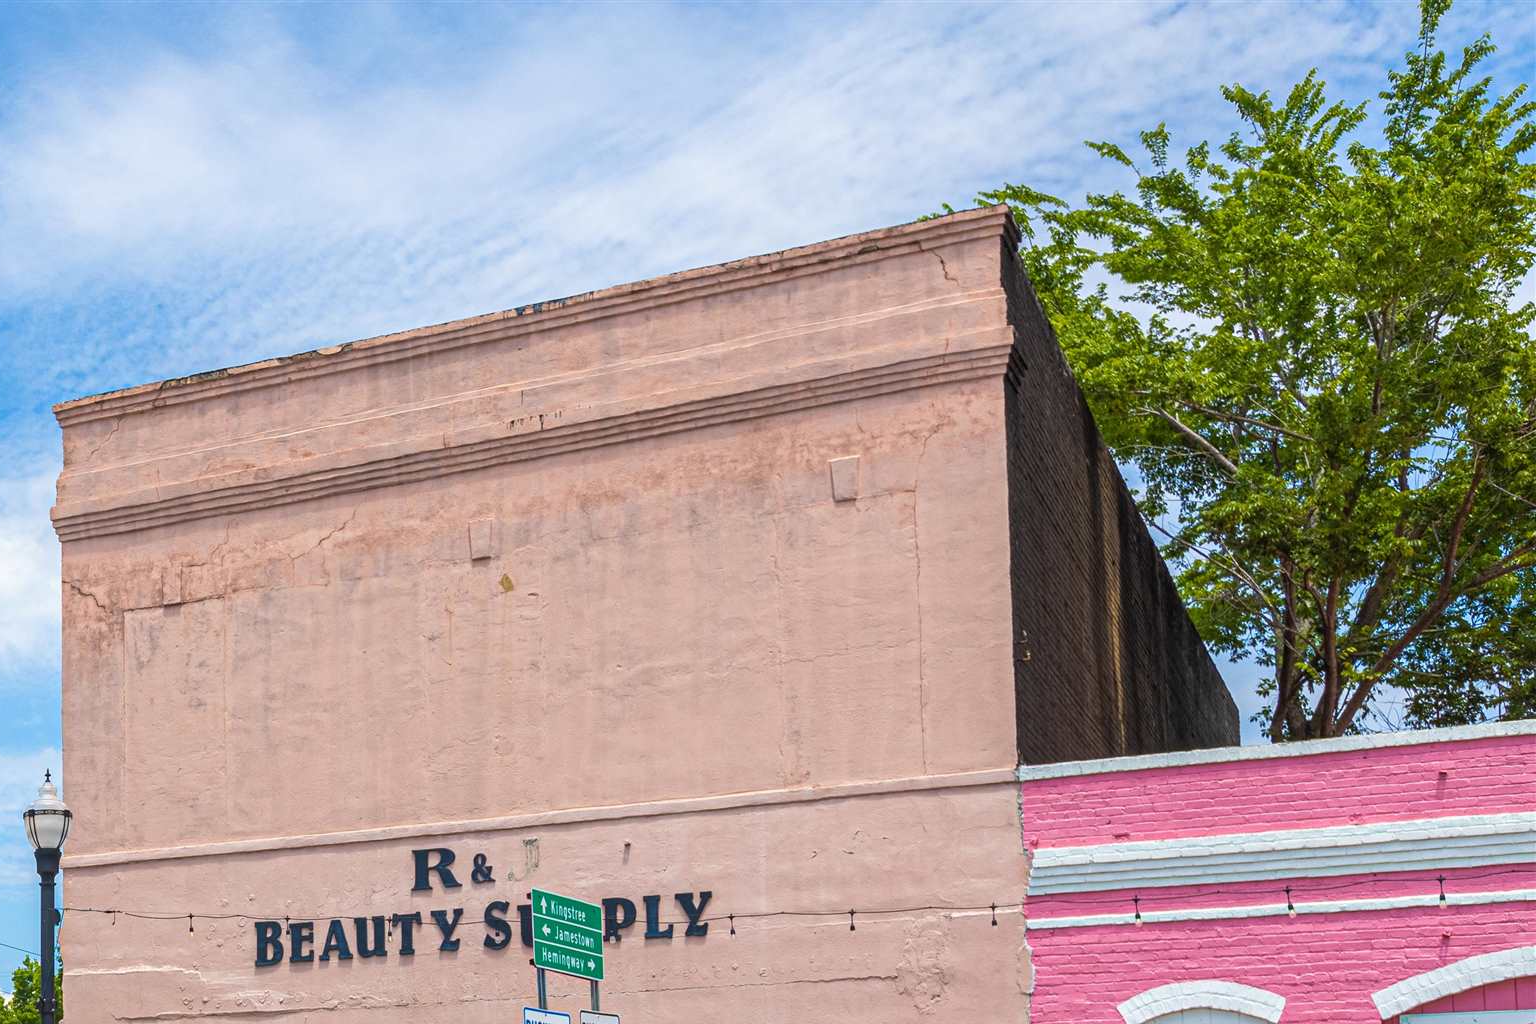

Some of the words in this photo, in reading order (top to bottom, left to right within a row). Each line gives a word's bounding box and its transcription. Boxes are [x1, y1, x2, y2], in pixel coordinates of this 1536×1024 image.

[411, 848, 462, 891] R
[471, 853, 495, 883] &
[550, 899, 586, 922] Kingstree
[255, 908, 463, 967] BEAUTY
[555, 926, 595, 948] Jamestown
[542, 948, 585, 972] Hemingway
